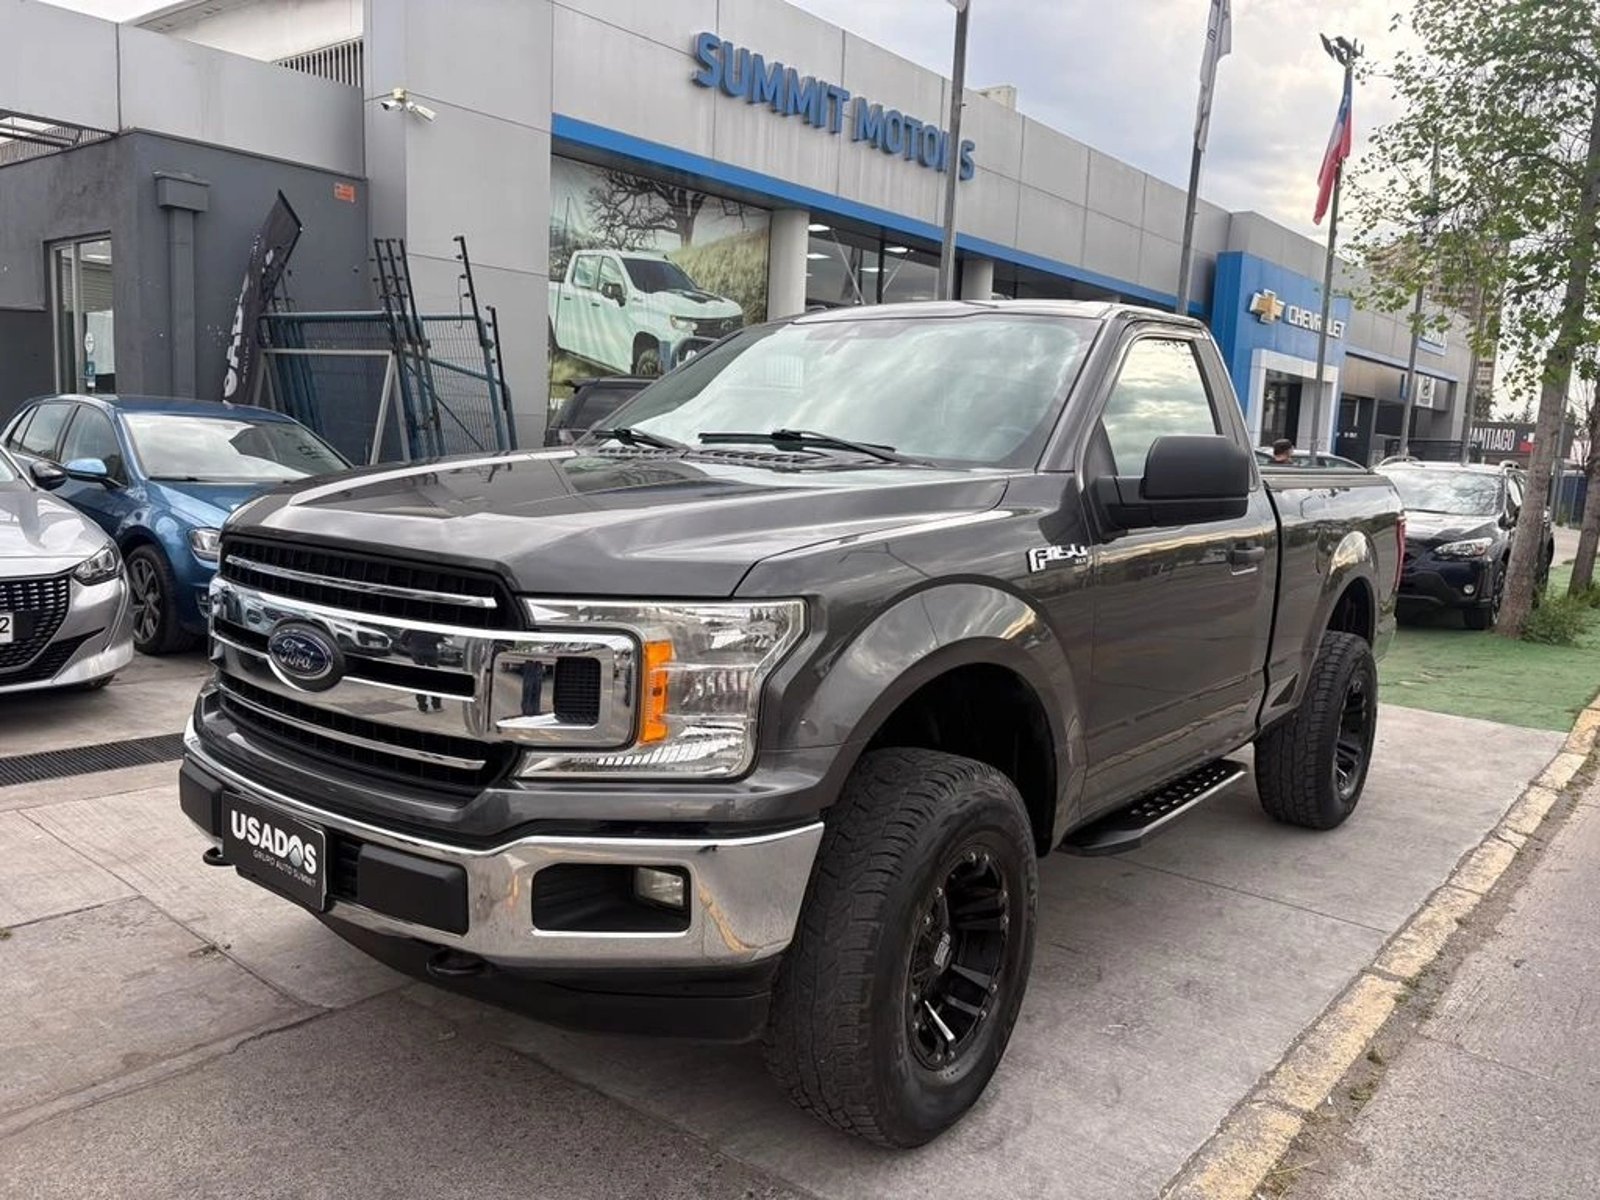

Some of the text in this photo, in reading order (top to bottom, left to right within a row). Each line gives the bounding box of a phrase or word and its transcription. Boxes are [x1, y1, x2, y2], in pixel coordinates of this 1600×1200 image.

[691, 31, 850, 134] SUMMIT
[1287, 305, 1344, 338] CHEVRLET
[279, 638, 315, 670] Ford
[231, 809, 317, 874] USADOS
